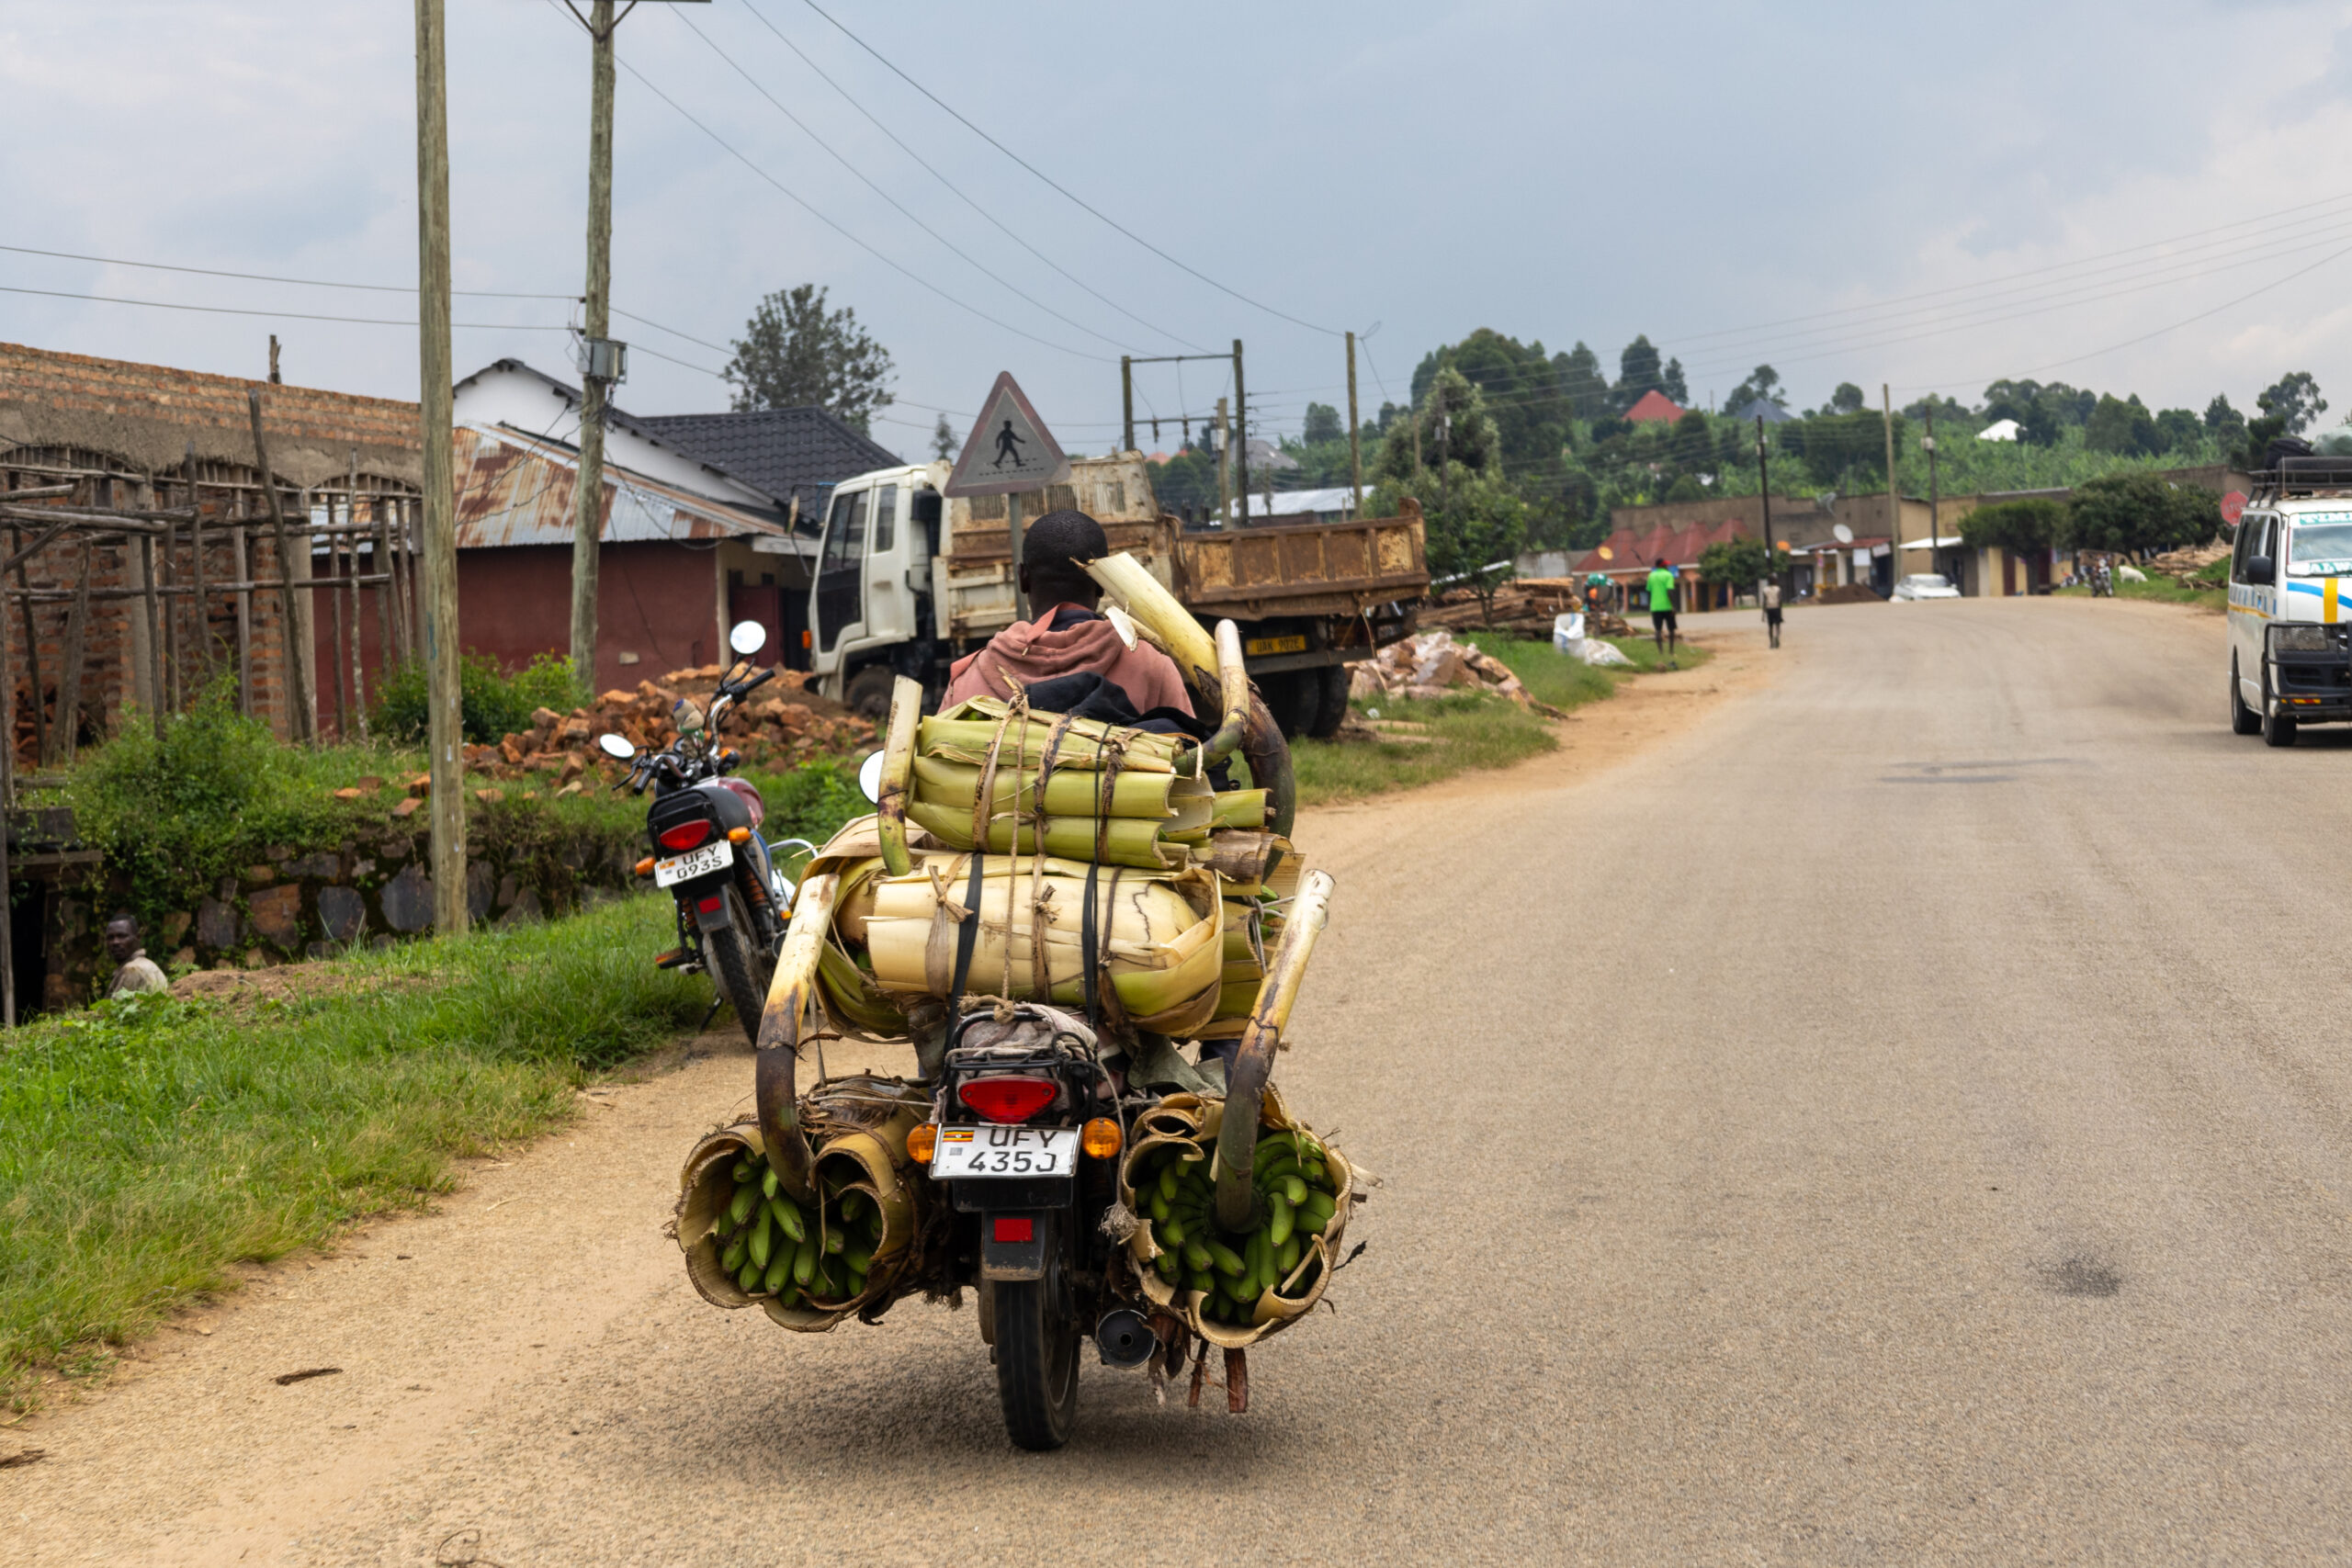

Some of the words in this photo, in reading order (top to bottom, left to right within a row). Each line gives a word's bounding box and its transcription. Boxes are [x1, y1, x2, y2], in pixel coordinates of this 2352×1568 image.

[683, 846, 717, 864] UFY
[677, 856, 722, 878] 093S
[989, 1129, 1058, 1148] UFY
[968, 1151, 1057, 1172] 435J
